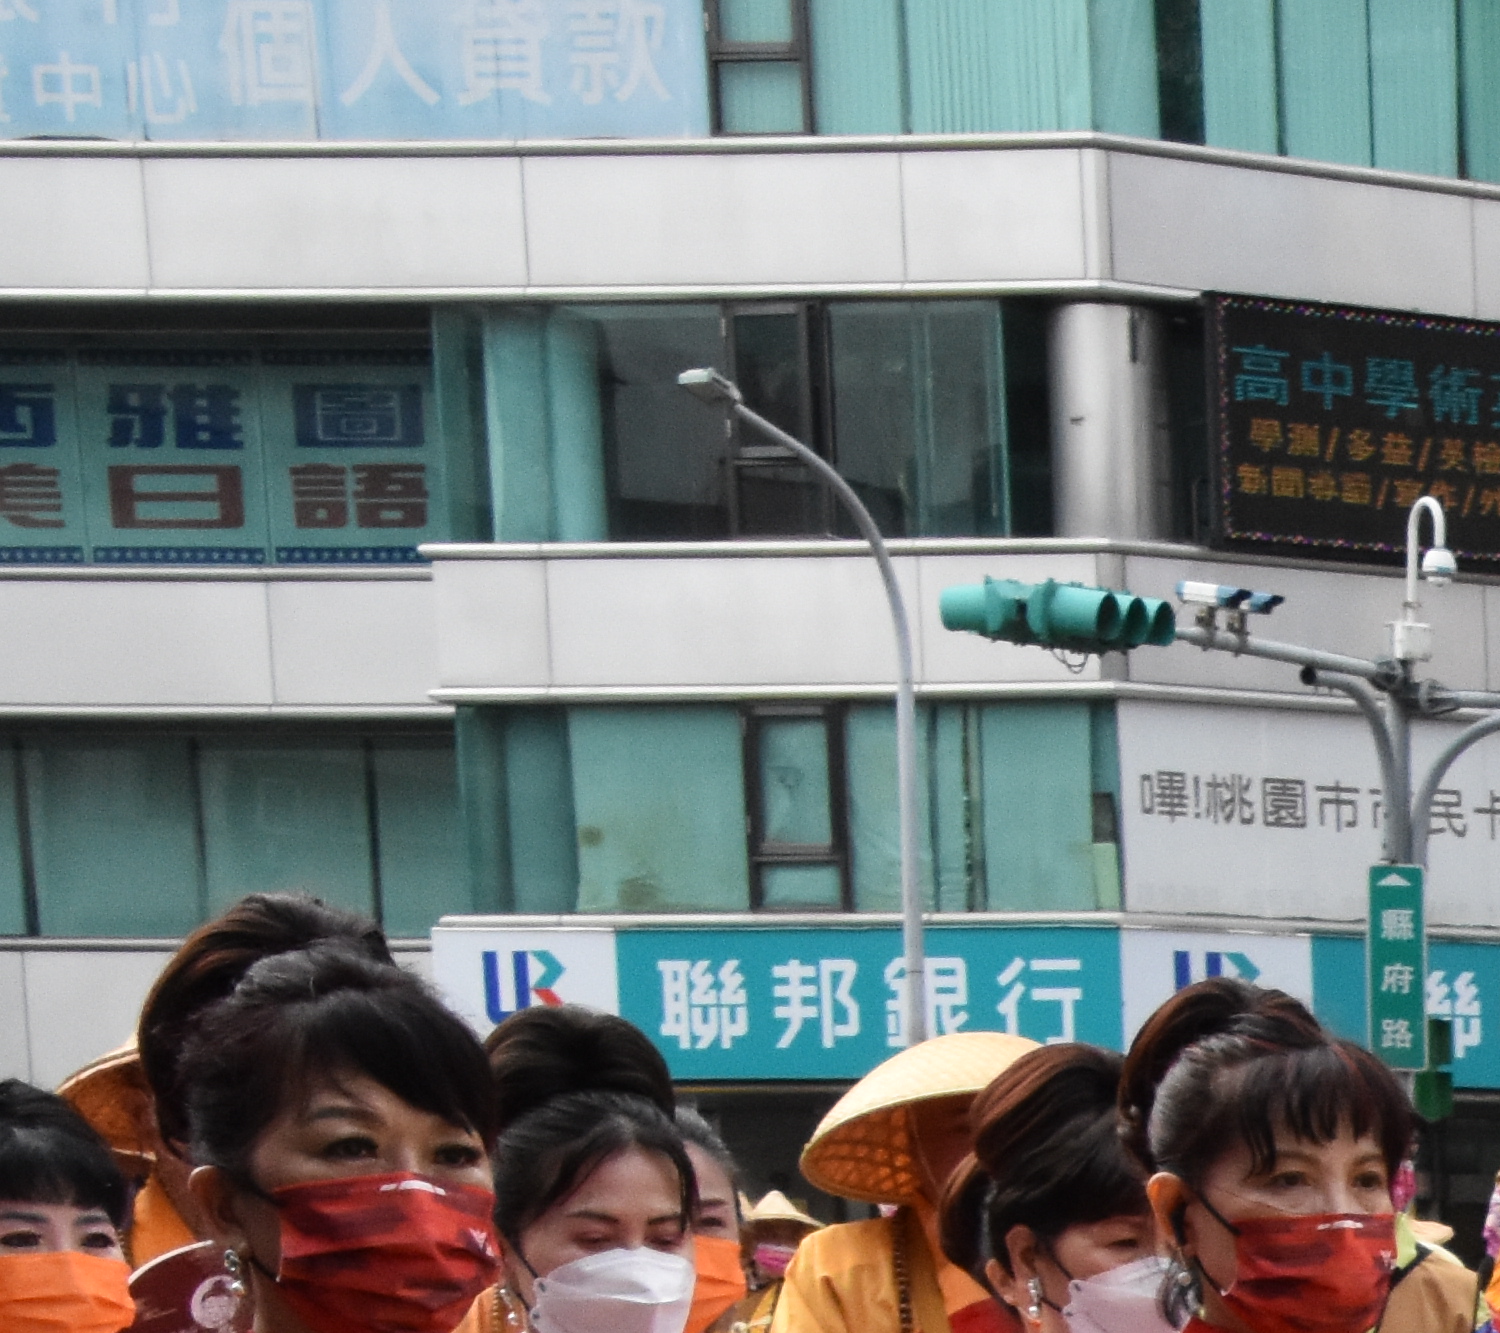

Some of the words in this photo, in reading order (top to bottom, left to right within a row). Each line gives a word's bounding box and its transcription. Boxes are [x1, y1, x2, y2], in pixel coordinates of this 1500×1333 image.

[0, 52, 198, 124] 中心
[218, 0, 673, 107] 個人貸款
[656, 957, 1084, 1050] 聯邦銀行
[1380, 908, 1416, 1050] 縣府路
